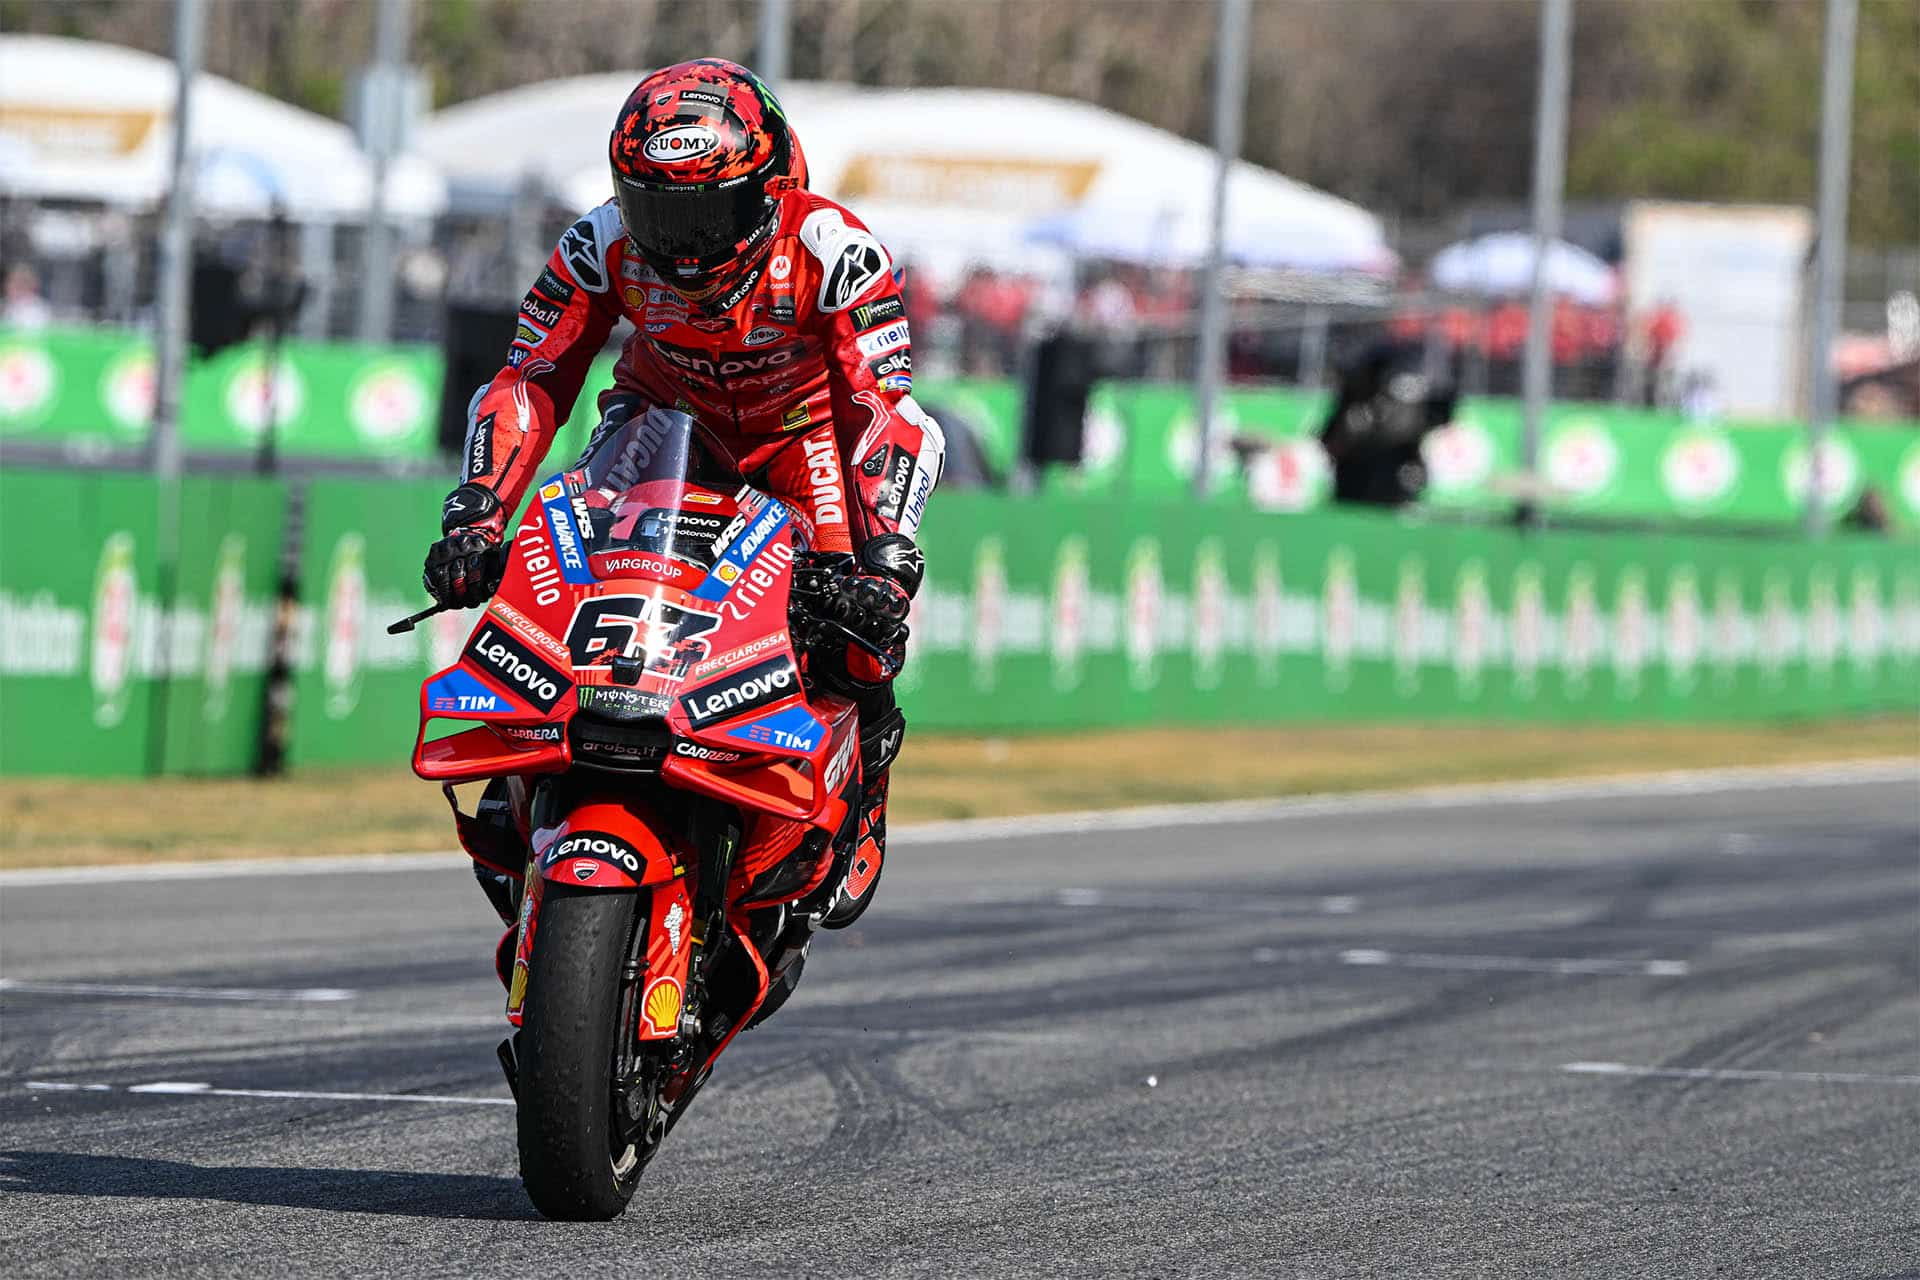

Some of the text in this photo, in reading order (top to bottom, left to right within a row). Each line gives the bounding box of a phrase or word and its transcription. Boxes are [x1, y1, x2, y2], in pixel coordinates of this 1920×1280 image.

[682, 91, 721, 104] Lenovo
[650, 137, 711, 151] SUOMY
[777, 178, 798, 191] 63
[721, 269, 758, 310] Lenovo
[521, 299, 559, 326] uba.it
[876, 325, 909, 346] riell
[652, 339, 792, 377] Lenovo
[877, 355, 912, 375] elic
[472, 417, 491, 474] Lenovo
[606, 404, 673, 492] DUCAT
[879, 455, 911, 518] Lenovo
[905, 466, 931, 528] Unipol
[549, 507, 583, 569] ADVANCE
[571, 496, 594, 540] WRS
[658, 511, 721, 528] Lenovo
[710, 512, 747, 559] WRS
[740, 502, 787, 562] ADVANCE
[519, 534, 561, 607] riello
[736, 541, 794, 608] riello
[493, 602, 571, 660] FRECCIAROSSA
[562, 593, 723, 680] 63
[474, 630, 558, 700] Lenovo
[695, 633, 787, 675] FRECCIAROSSA
[457, 695, 496, 710] TIM
[595, 689, 669, 711] MONSTER
[687, 669, 792, 720] Lenovo
[507, 727, 560, 740] CARRERA
[675, 742, 740, 762] CARRERA
[773, 730, 812, 751] TIM
[545, 838, 640, 872] Lenovo
